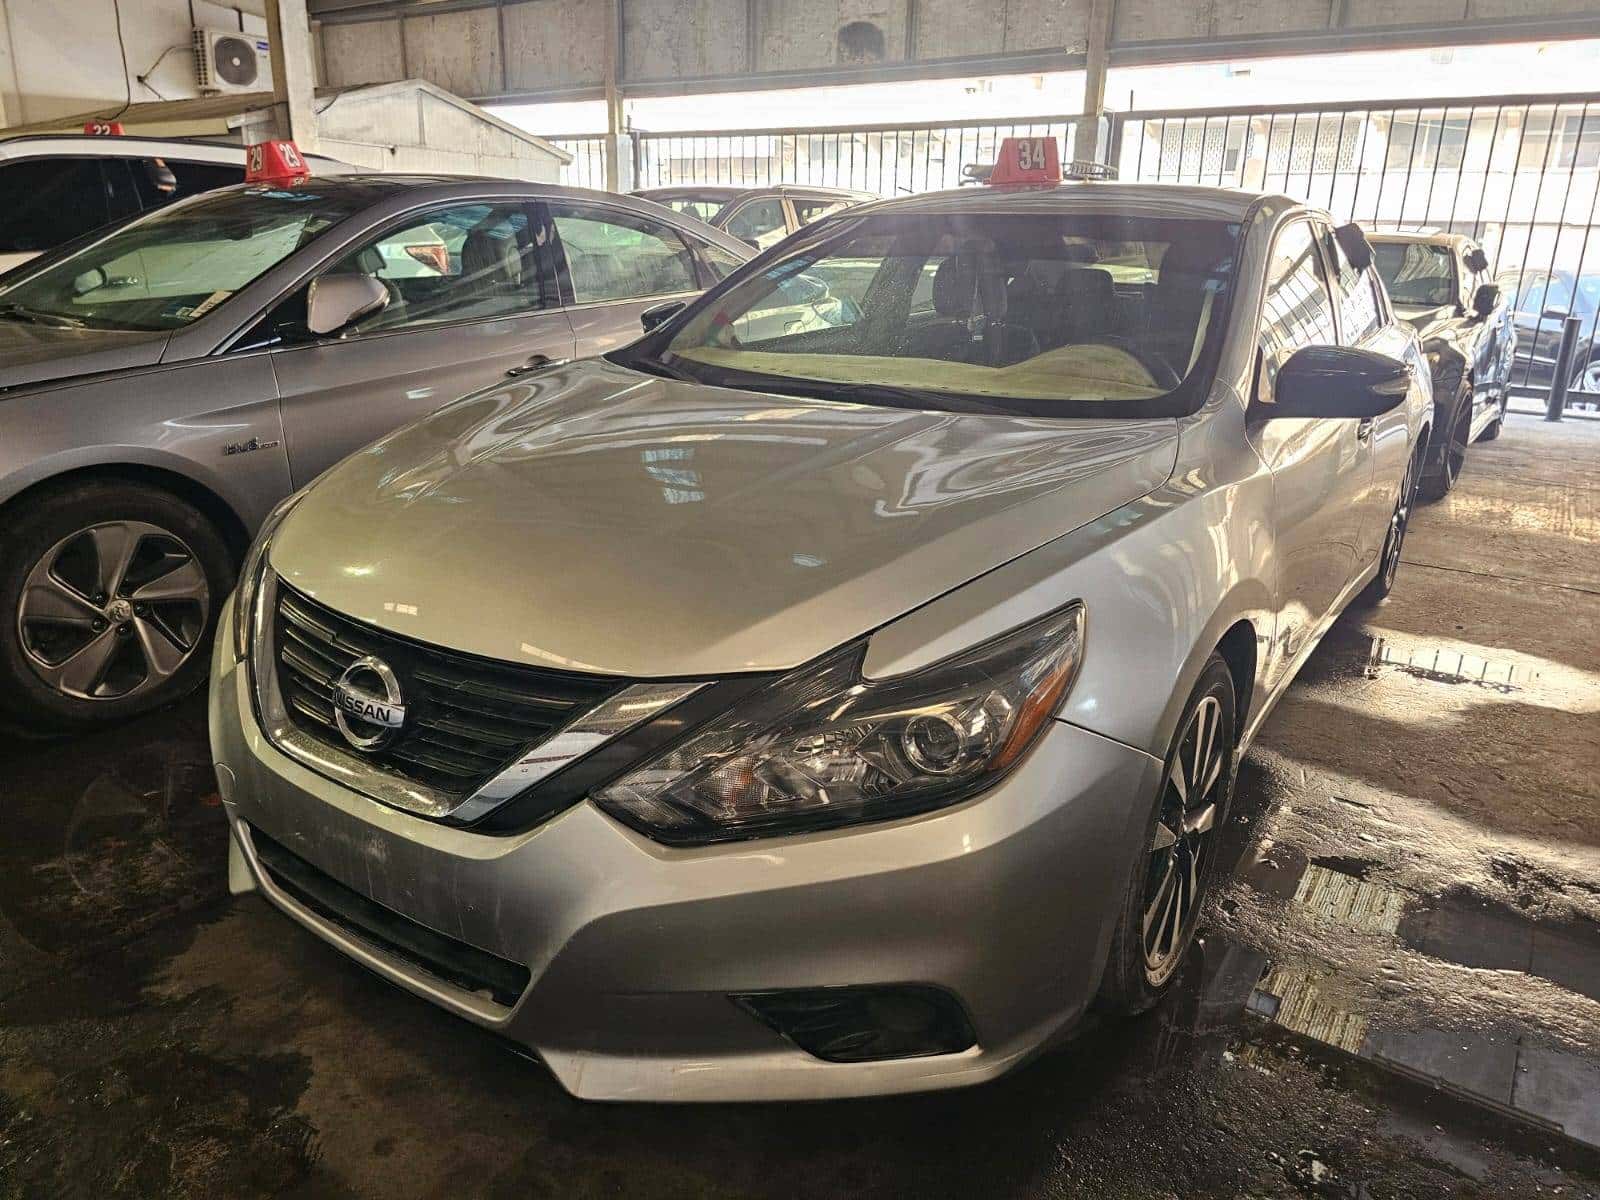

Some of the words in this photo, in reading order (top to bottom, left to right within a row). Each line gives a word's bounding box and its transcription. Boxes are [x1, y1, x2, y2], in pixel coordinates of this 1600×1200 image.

[250, 145, 263, 172] 29
[279, 143, 301, 168] 29
[1018, 139, 1046, 170] 34
[334, 687, 391, 722] NISSAN
